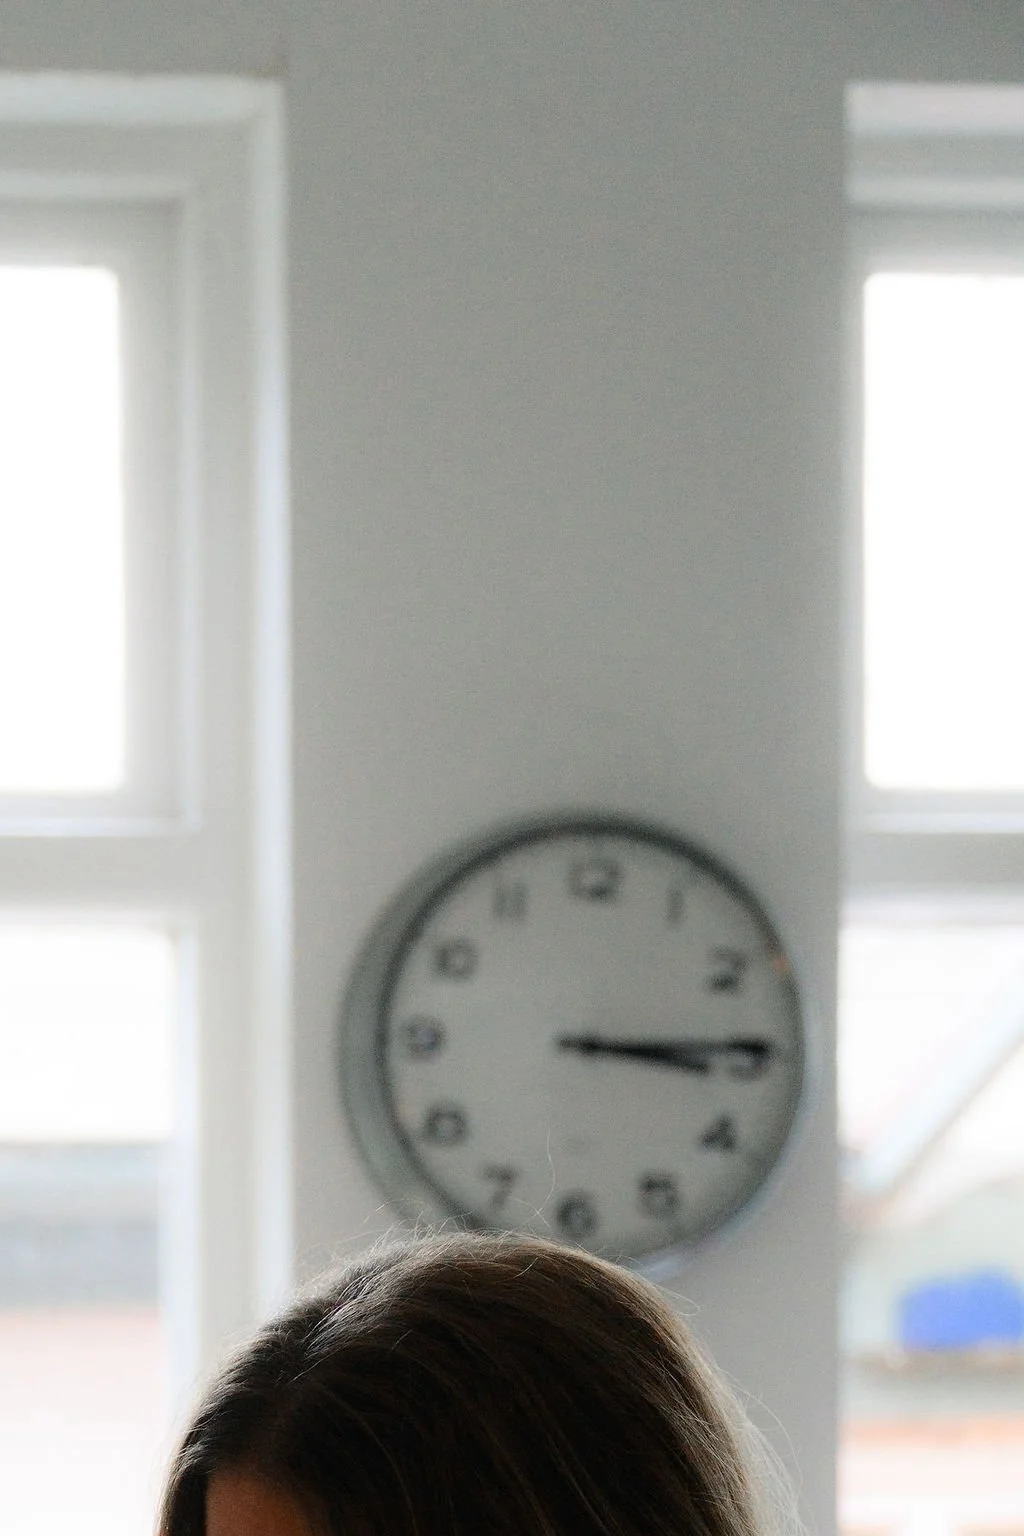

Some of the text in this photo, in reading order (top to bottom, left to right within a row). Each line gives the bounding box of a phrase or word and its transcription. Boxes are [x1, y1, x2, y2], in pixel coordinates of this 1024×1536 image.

[706, 947, 747, 994] 2
[699, 1113, 737, 1153] 4
[483, 1165, 517, 1212] 7
[638, 1172, 677, 1218] 5
[555, 1192, 597, 1239] 6
